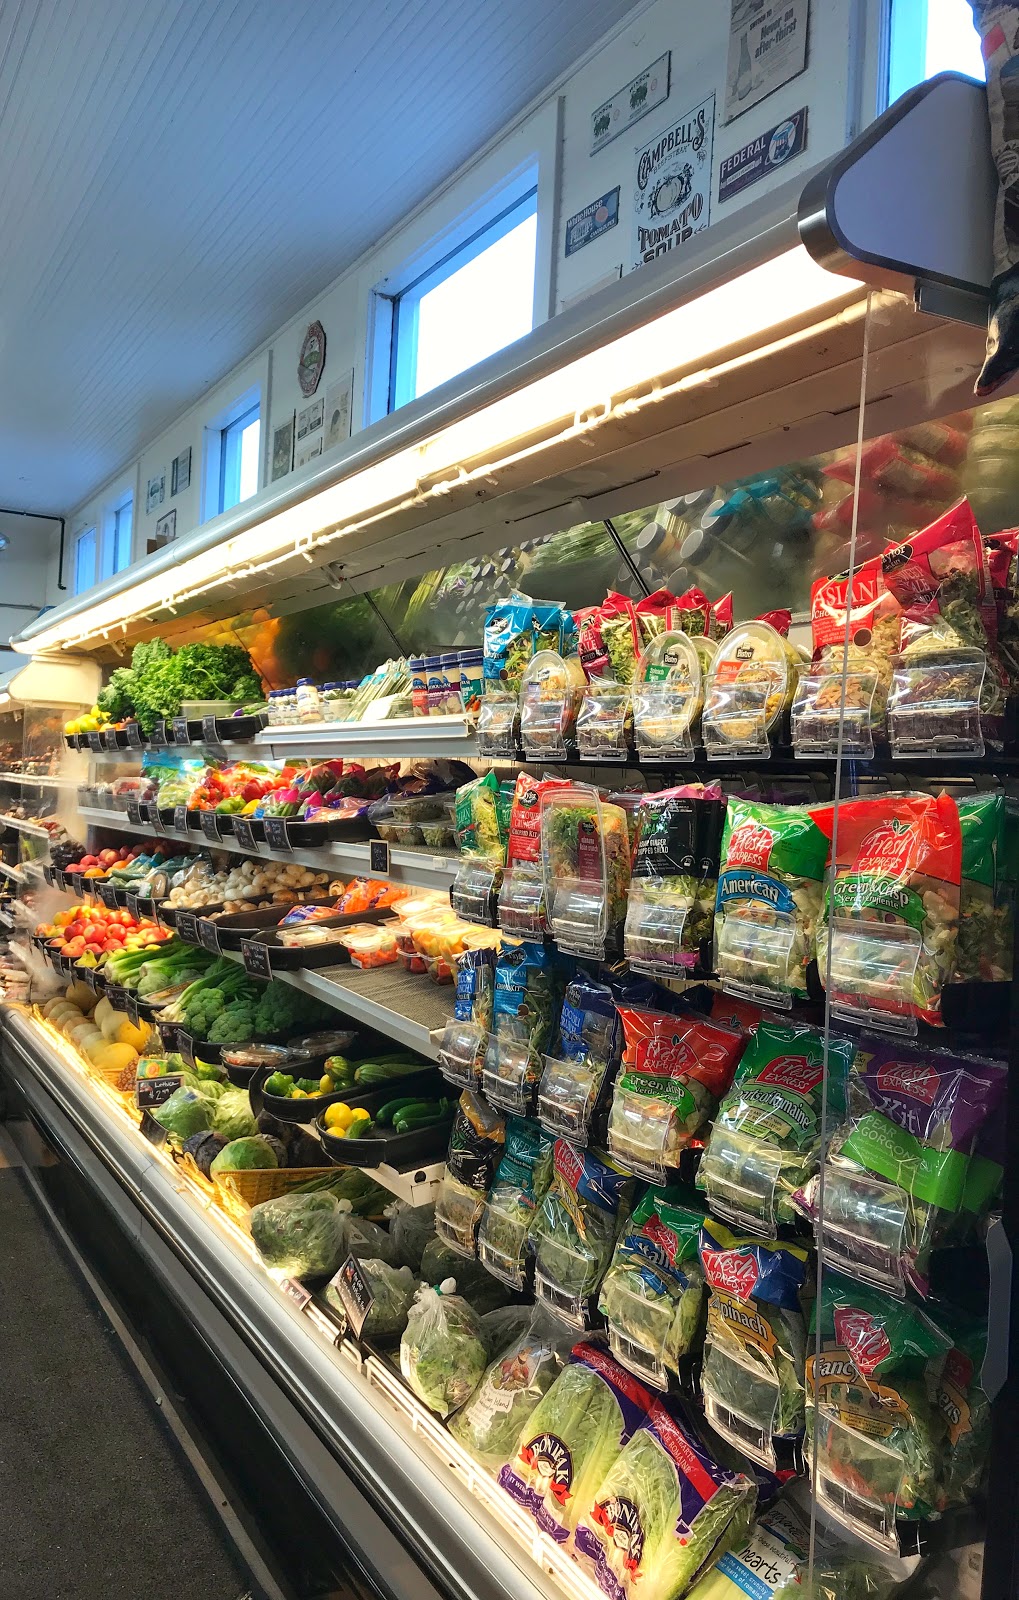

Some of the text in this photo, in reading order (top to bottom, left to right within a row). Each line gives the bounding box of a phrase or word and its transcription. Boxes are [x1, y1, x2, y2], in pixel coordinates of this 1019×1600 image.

[755, 18, 797, 58] after-thirst
[761, 16, 782, 40] Never
[637, 108, 705, 190] CAMPBELL'S
[721, 137, 766, 178] FEDERAL
[638, 193, 703, 253] TOMATO
[882, 545, 906, 563] aylor
[814, 580, 875, 607] ASIAN
[737, 649, 753, 658] Bistro
[866, 831, 909, 856] Fresh
[730, 851, 763, 866] EXPRESS
[859, 857, 902, 869] EXPRESS
[721, 874, 779, 903] American
[646, 1040, 688, 1063] Fresh
[764, 1072, 810, 1089] EXPRESS
[773, 1058, 822, 1081] Fresh
[885, 1062, 932, 1086] Fresh
[883, 1077, 928, 1097] EXPRESS
[865, 1114, 898, 1138] PEAR
[556, 1158, 576, 1183] EXPRESS
[708, 1253, 753, 1279] Fresh
[670, 1441, 692, 1474] ROMAINE
[738, 1543, 782, 1584] hearts
[736, 1563, 749, 1579] sweet
[749, 1576, 769, 1595] crunchy
[743, 1581, 763, 1600] romaine
